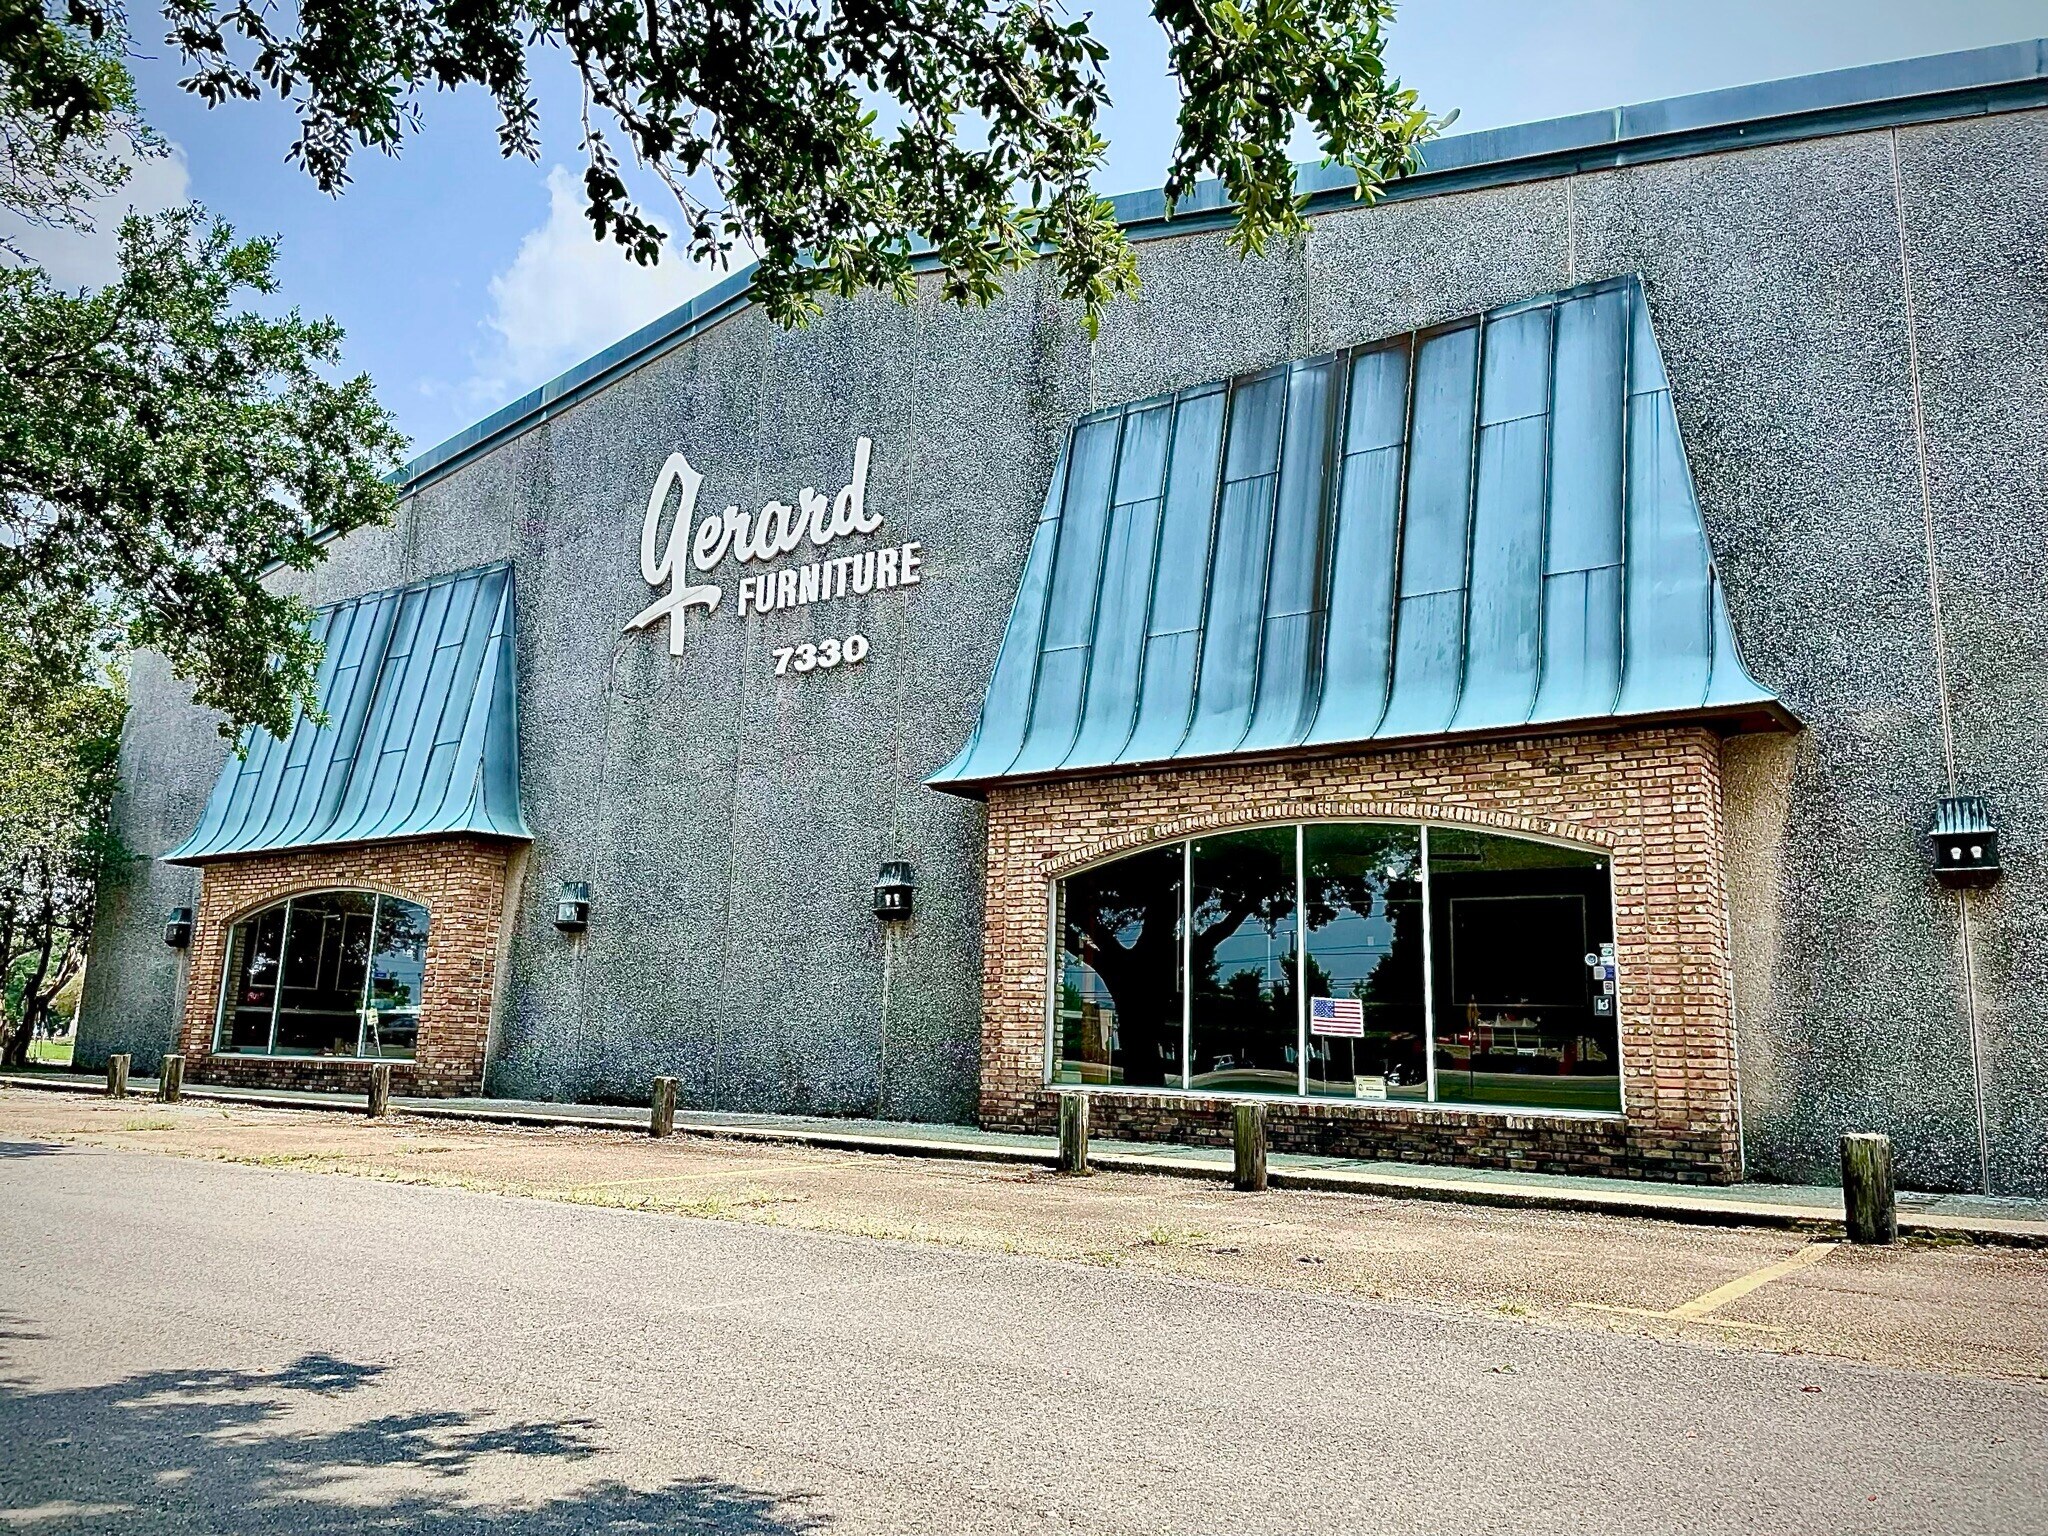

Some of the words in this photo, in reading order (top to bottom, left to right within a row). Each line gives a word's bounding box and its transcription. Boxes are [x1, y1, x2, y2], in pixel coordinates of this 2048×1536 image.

[622, 436, 884, 656] Gerard
[737, 541, 922, 617] FURNITURE
[772, 635, 870, 677] 7330
